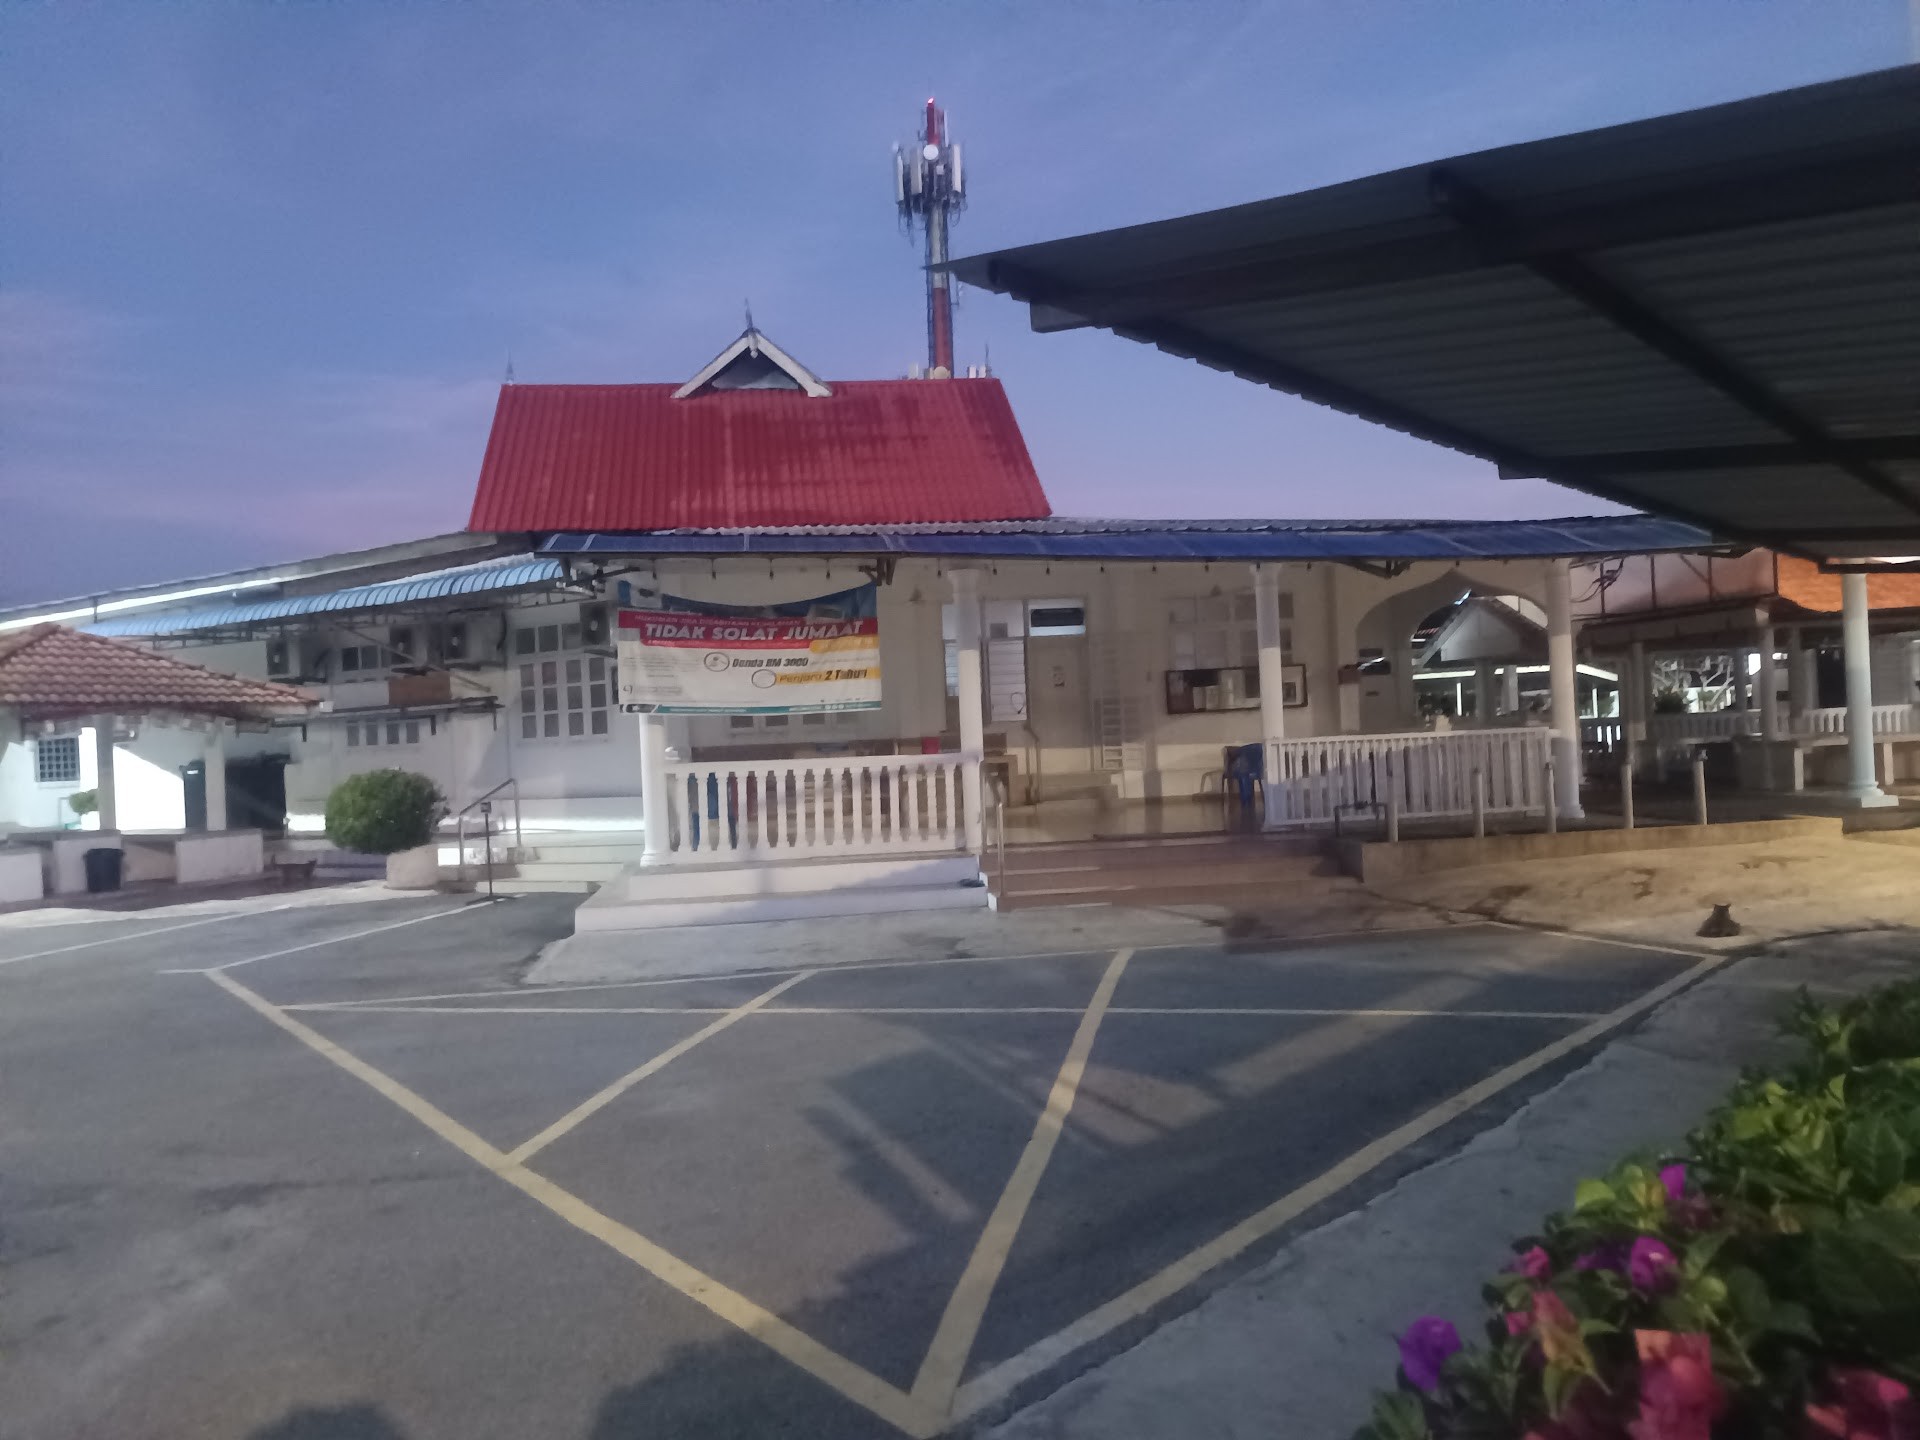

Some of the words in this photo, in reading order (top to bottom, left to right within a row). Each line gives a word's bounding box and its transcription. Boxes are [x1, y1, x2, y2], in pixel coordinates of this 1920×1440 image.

[645, 623, 706, 639] TIDAK
[711, 626, 778, 641] SOLAT
[783, 620, 864, 640] JUMAAT
[824, 670, 832, 681] 2
